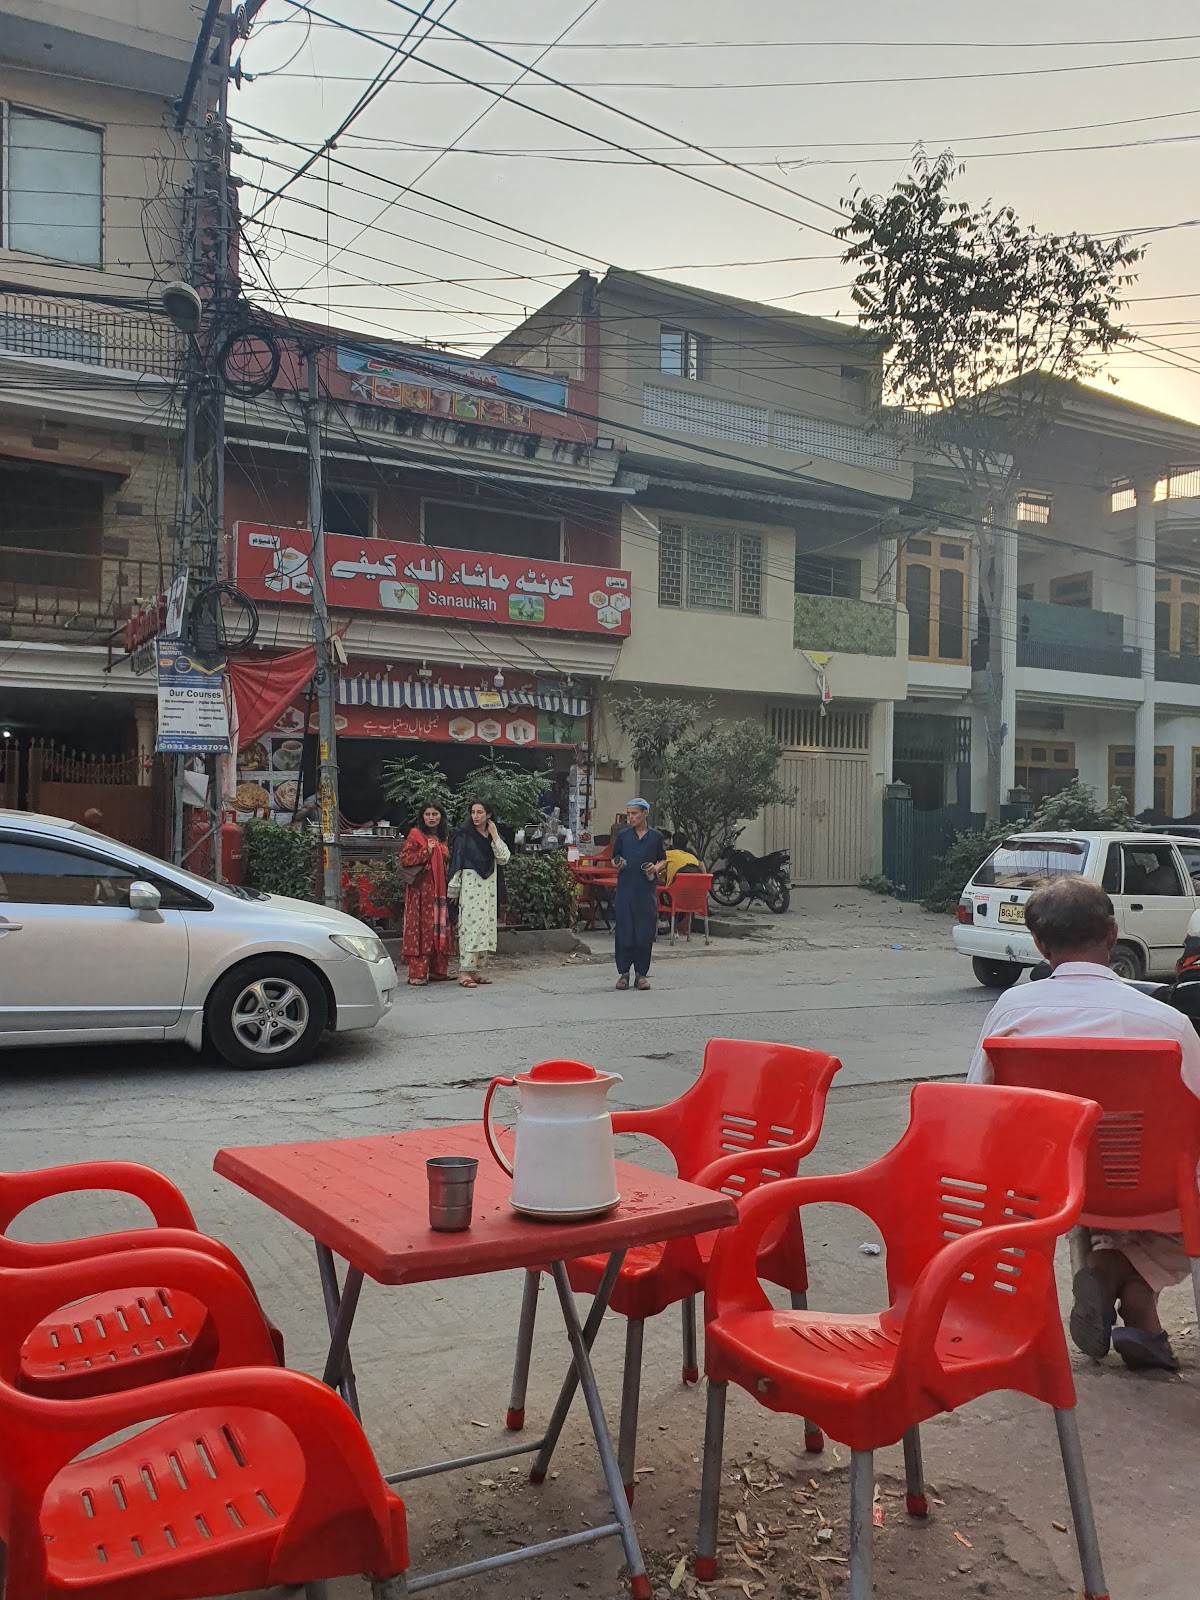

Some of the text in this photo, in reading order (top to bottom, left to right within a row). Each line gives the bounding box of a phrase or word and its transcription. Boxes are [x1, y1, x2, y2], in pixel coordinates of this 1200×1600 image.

[330, 549, 574, 600] کوئٹہ ماشاء اللہ کیفے
[428, 590, 497, 612] Sanaullah
[169, 689, 221, 698] Our Courses
[1001, 908, 1026, 919] BGJ-83
